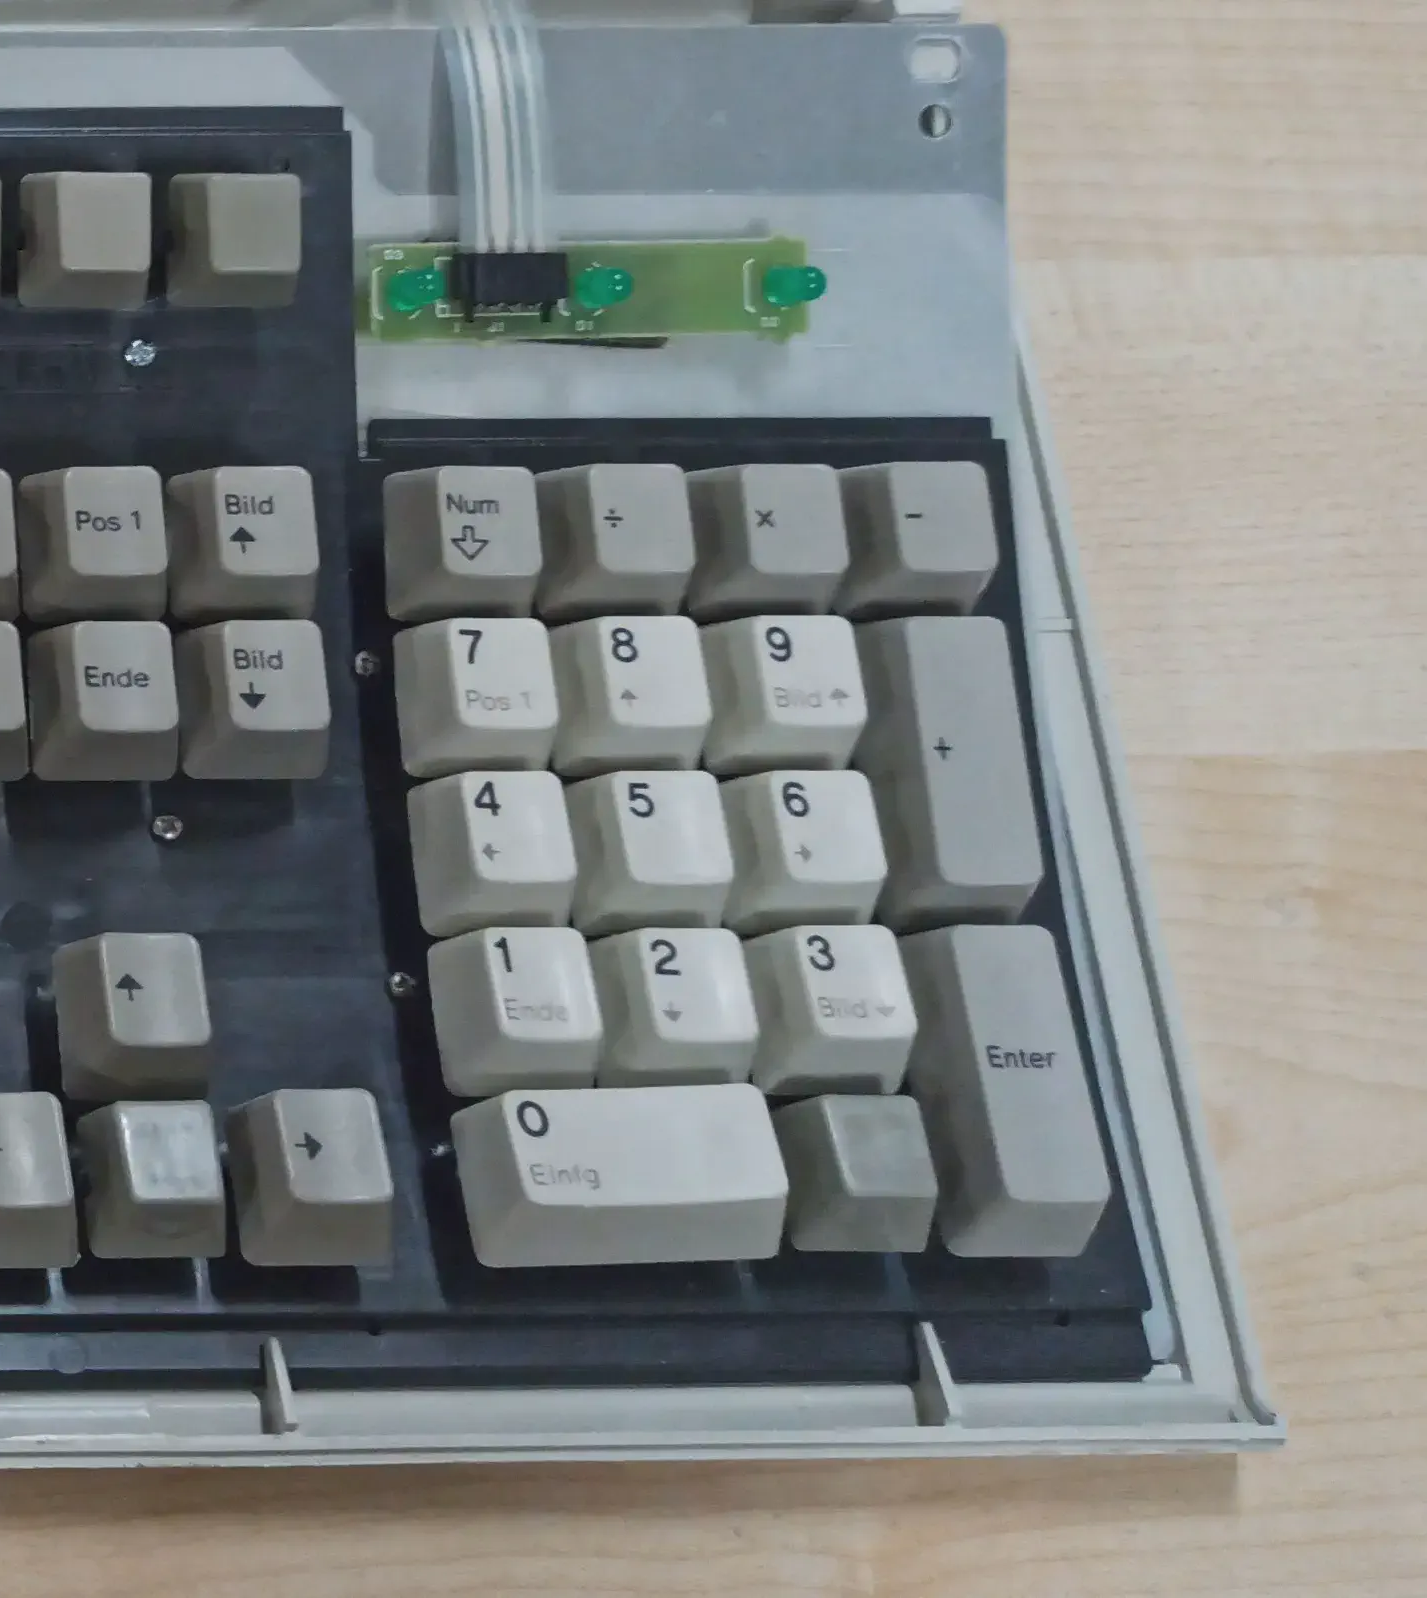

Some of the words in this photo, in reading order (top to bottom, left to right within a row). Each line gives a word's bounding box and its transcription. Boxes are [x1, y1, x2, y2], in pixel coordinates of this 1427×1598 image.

[74, 509, 122, 533] Pos
[224, 493, 275, 516] Bild
[445, 492, 500, 515] Num
[232, 648, 284, 671] Bild
[458, 628, 483, 665] 7
[610, 627, 639, 664] 8
[765, 626, 793, 663] 9
[83, 665, 150, 689] Ende
[933, 740, 953, 760] +
[474, 780, 502, 817] 4
[628, 782, 655, 819] 5
[781, 781, 810, 818] 6
[493, 936, 513, 973] 1
[650, 938, 682, 976] 2
[806, 934, 836, 972] 3
[985, 1044, 1056, 1069] Enter
[516, 1100, 550, 1138] 0
